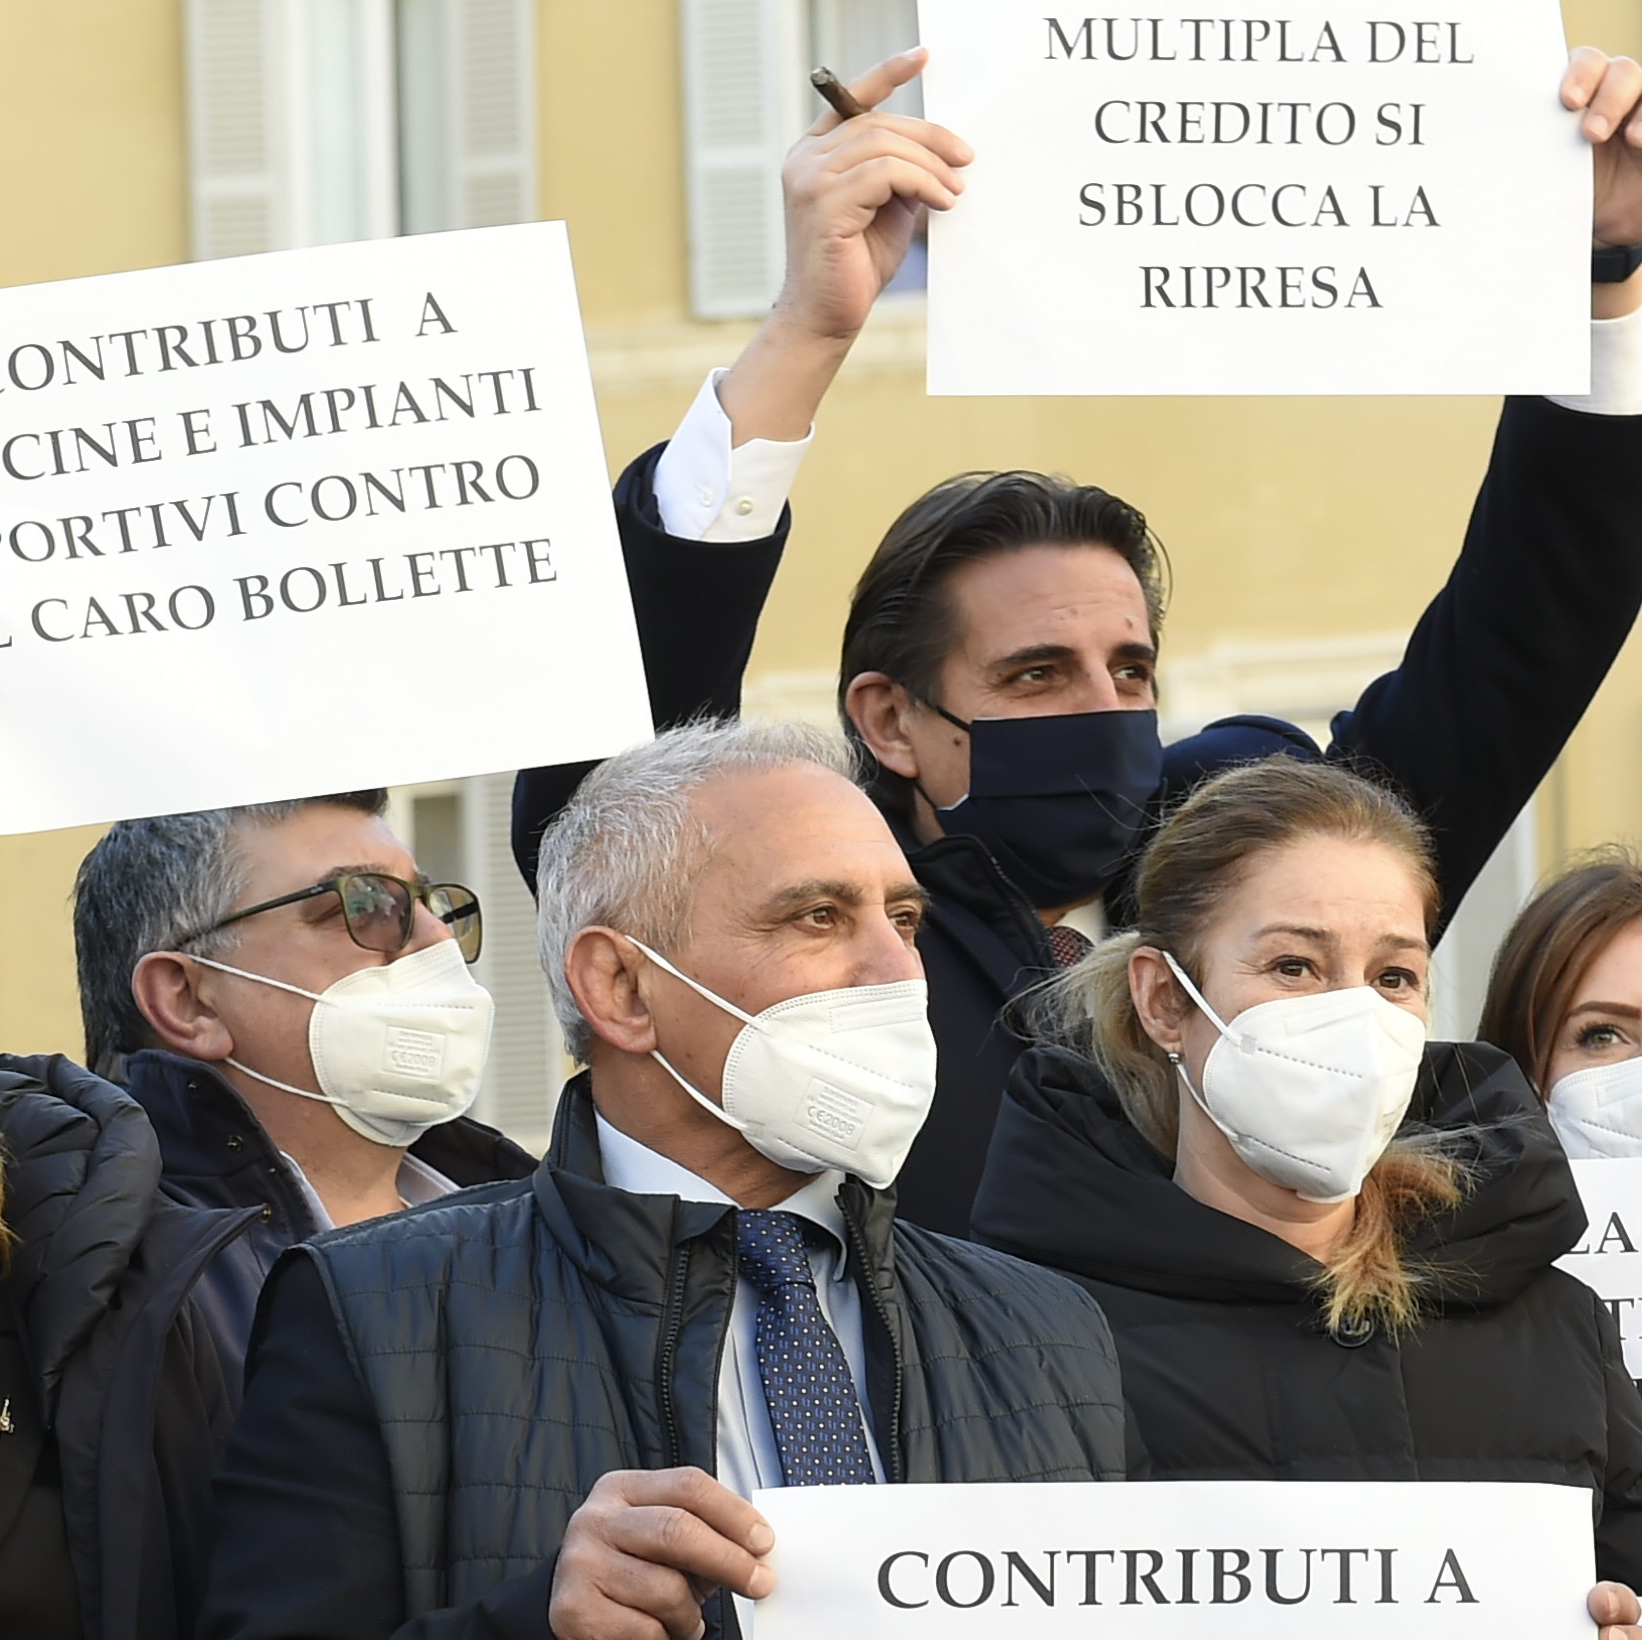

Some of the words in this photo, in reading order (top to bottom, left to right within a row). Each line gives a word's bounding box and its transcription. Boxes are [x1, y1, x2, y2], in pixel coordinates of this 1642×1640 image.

[1043, 17, 1347, 63] MULTIPLA
[1365, 20, 1474, 64] DEL
[1094, 99, 1356, 146] CREDITO
[1375, 102, 1425, 146] SI
[1079, 182, 1350, 228] SBLOCCA
[1367, 184, 1442, 228] LA
[1139, 265, 1383, 309] RIPRESA
[414, 291, 459, 338] A
[176, 408, 218, 457] E
[231, 367, 542, 449] IMPIANTI
[264, 454, 540, 528] CONTRO
[30, 584, 216, 643] CARO
[232, 538, 558, 622] BOLLETTE
[877, 1548, 1399, 1610] CONTRIBUTI
[1423, 1547, 1481, 1604] A
